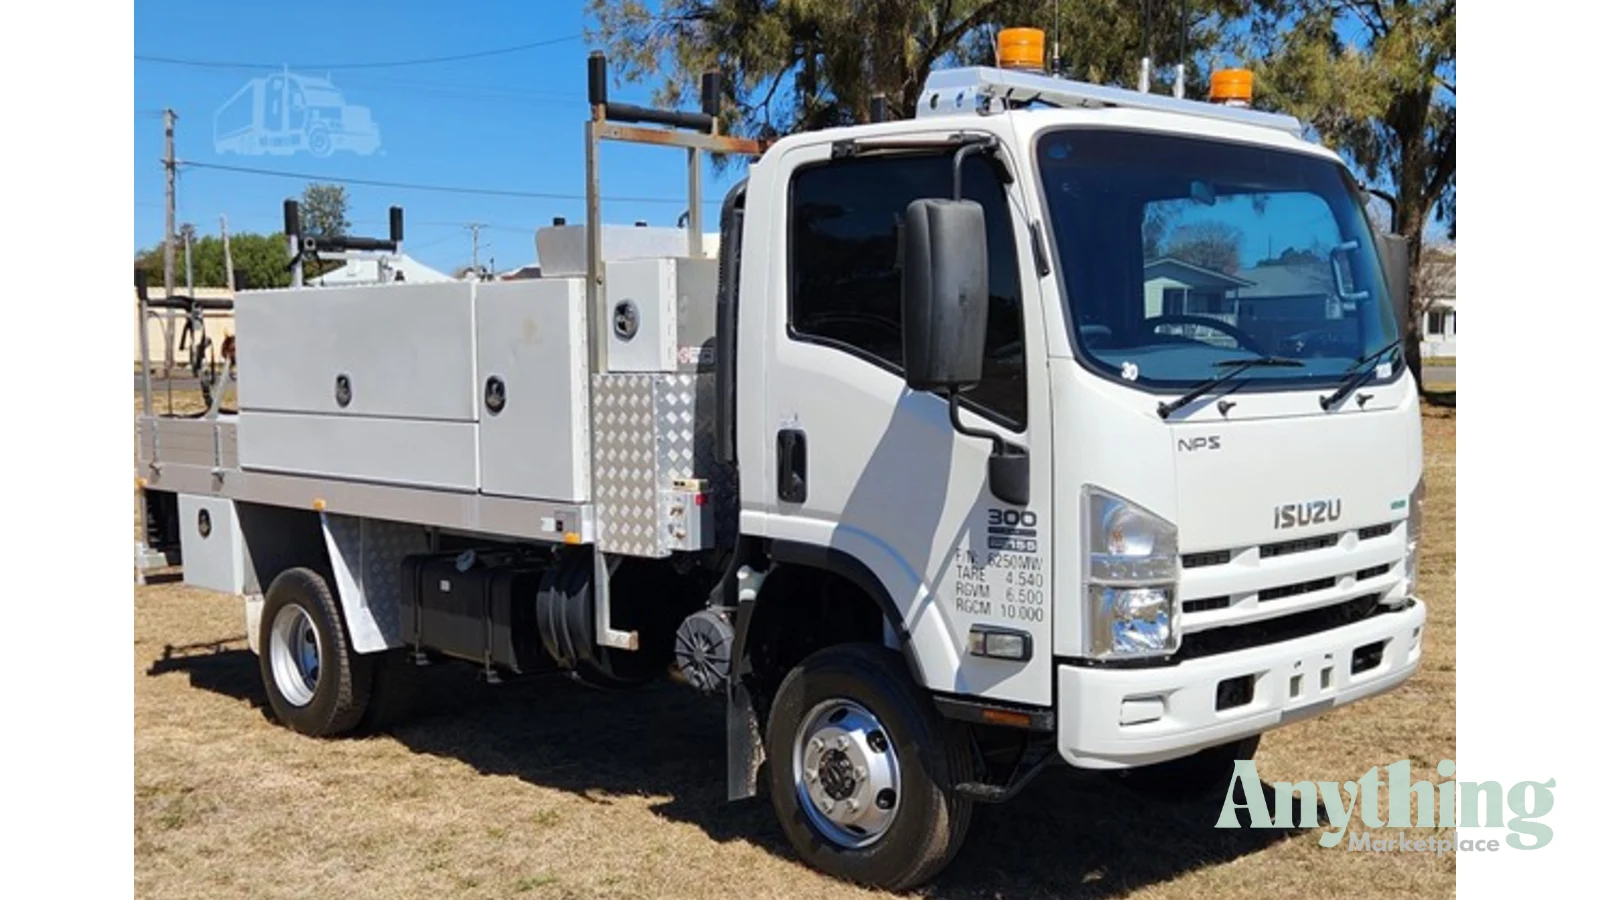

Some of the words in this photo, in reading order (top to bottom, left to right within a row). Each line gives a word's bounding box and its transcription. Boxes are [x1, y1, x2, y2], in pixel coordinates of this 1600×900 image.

[1178, 435, 1221, 452] NPS
[988, 508, 1037, 528] 300
[1274, 498, 1342, 529] ISUZU
[956, 564, 985, 582] TARE
[1006, 571, 1043, 587] 4.540
[956, 580, 991, 598] RGVM
[1006, 587, 1043, 605] 6.500
[956, 597, 992, 616] RGCM
